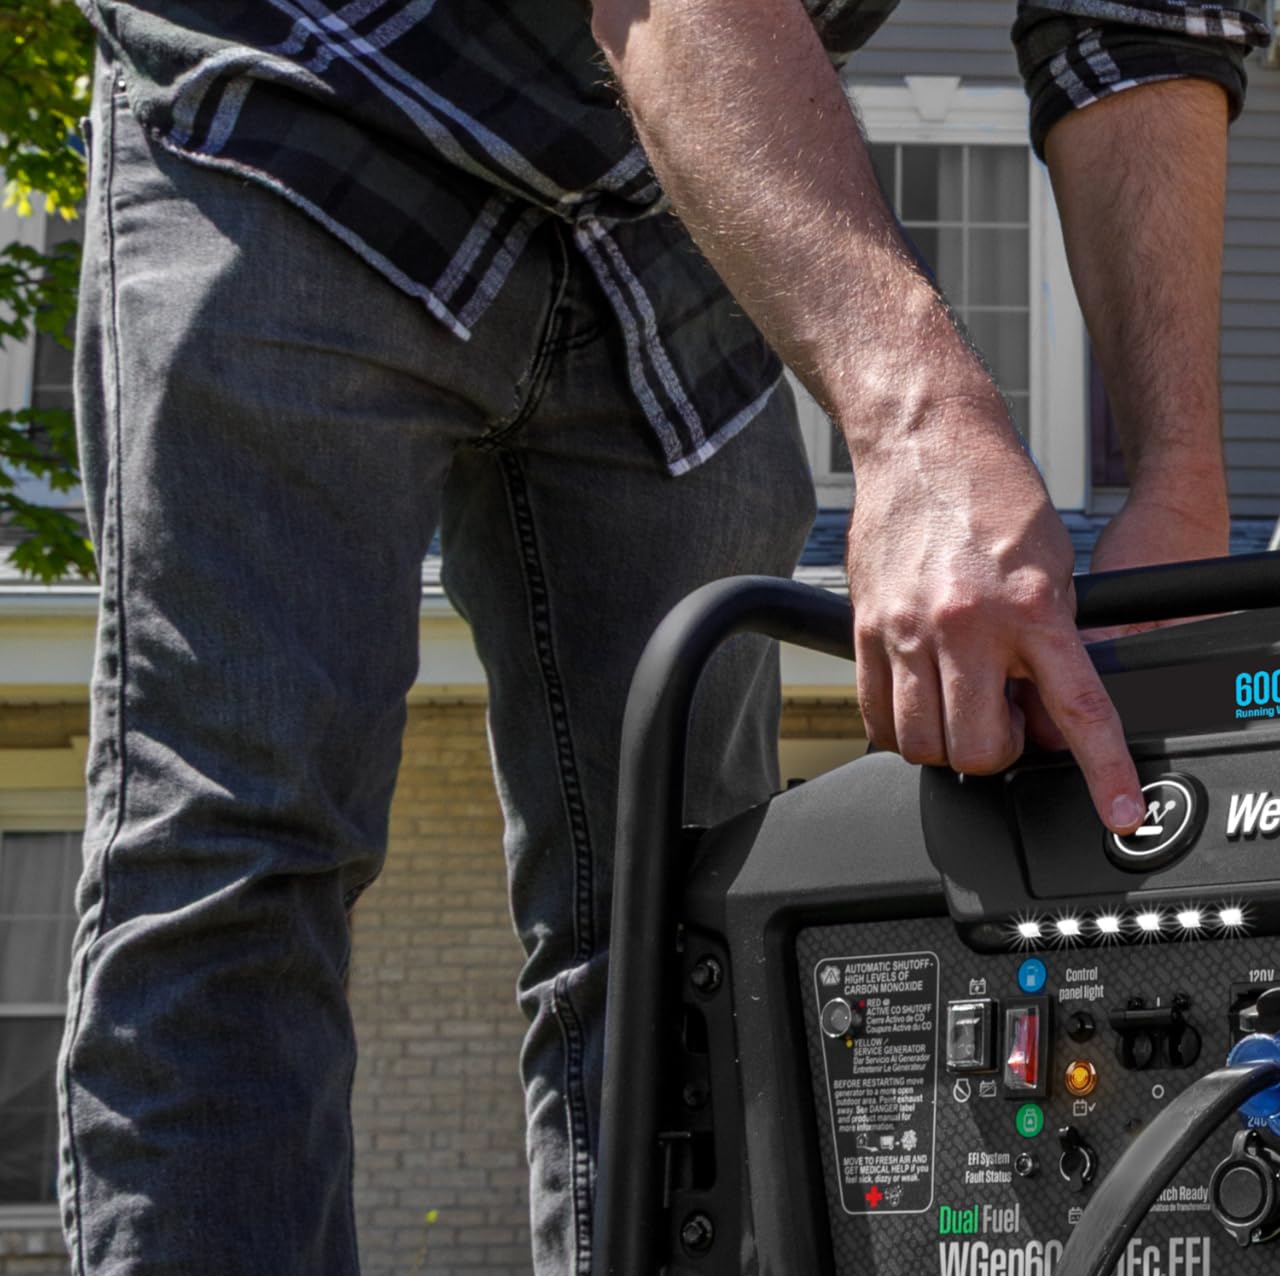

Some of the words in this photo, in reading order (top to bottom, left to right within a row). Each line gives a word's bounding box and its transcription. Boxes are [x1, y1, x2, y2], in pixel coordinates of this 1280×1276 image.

[1235, 705, 1275, 719] Running
[845, 962, 891, 974] AUTOMATIC
[1066, 966, 1098, 983] Control
[844, 975, 865, 985] HIGH
[866, 972, 896, 982] LEVELS
[898, 971, 910, 980] OF
[844, 983, 879, 995] CARBON
[880, 980, 923, 992] MONOXIDE
[1059, 984, 1082, 1002] panel
[1083, 982, 1104, 1000] light
[884, 1043, 926, 1055] GENERATOR
[968, 1152, 980, 1166] EFI
[980, 1151, 1010, 1168] System
[859, 1164, 890, 1175] MEDICAL
[890, 1163, 910, 1174] HELP
[965, 1170, 985, 1185] Fault
[985, 1170, 1013, 1184] Status
[1179, 1184, 1209, 1203] Ready
[939, 1204, 979, 1234] Dual
[982, 1203, 1021, 1234] Fuel
